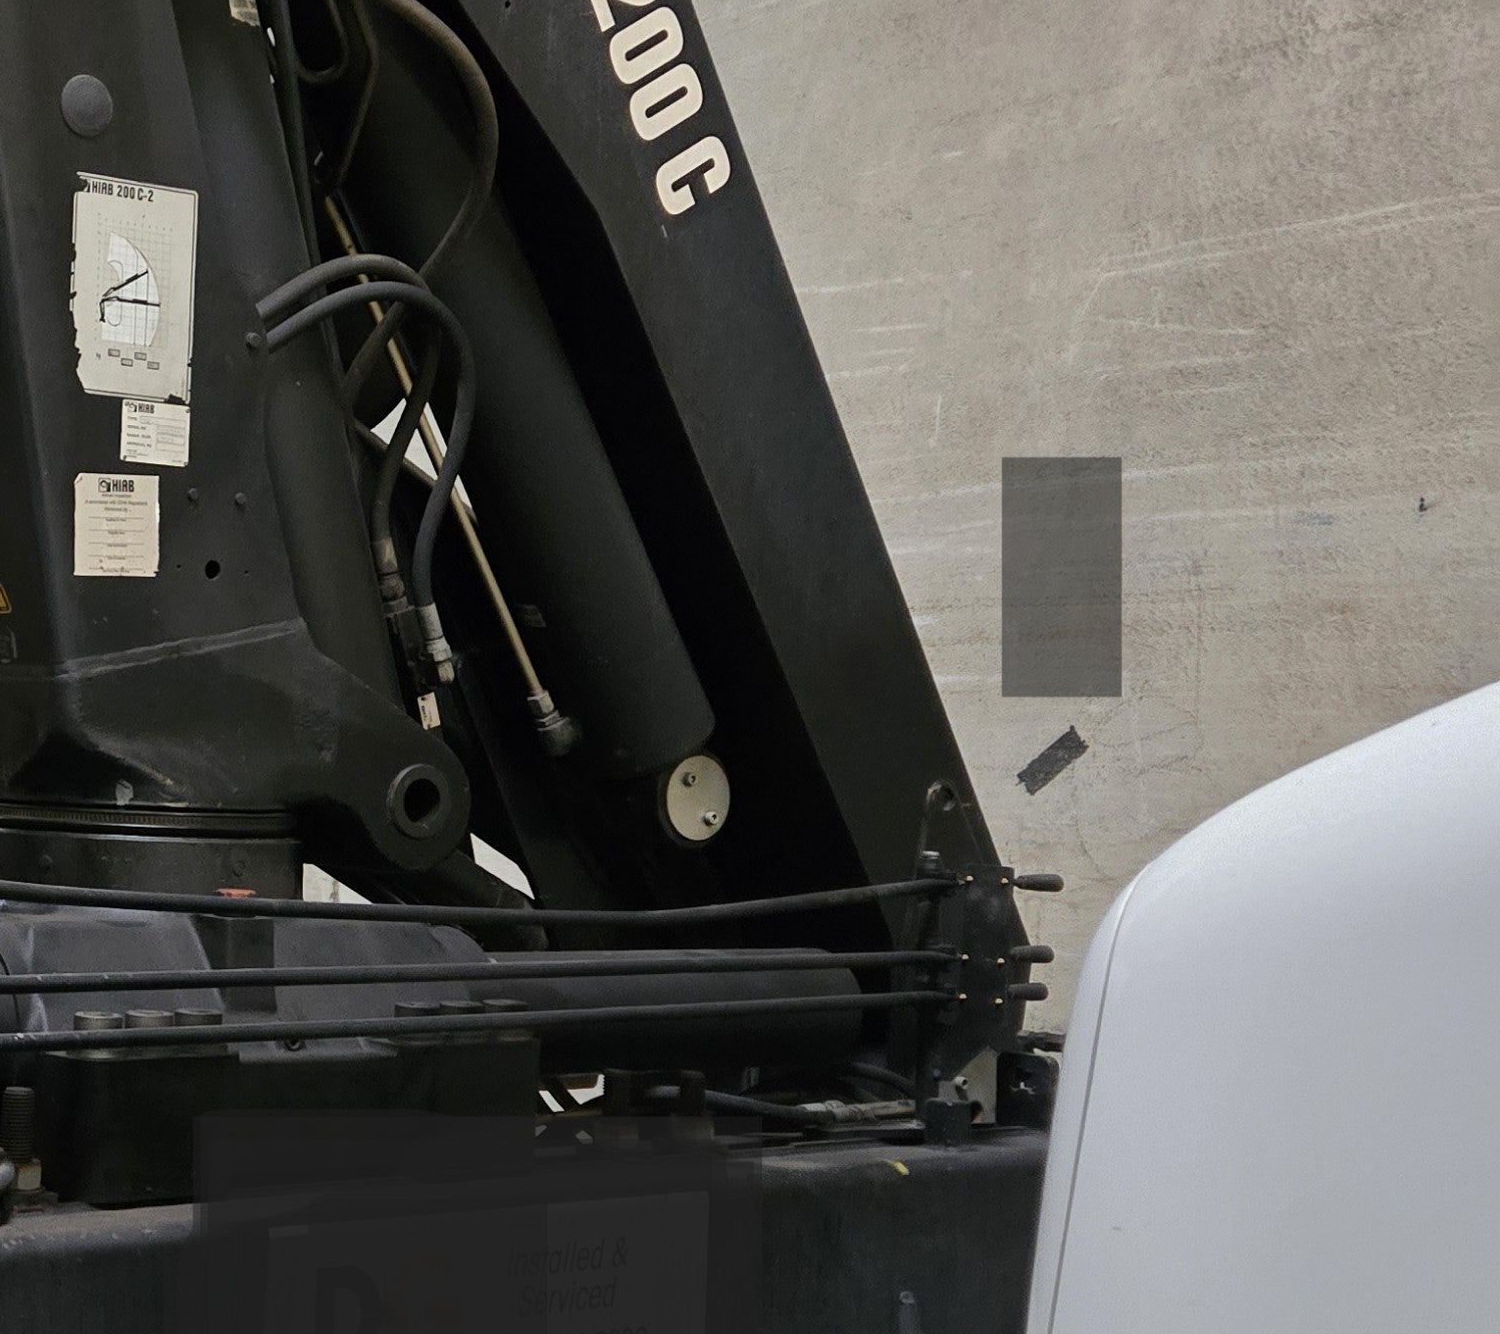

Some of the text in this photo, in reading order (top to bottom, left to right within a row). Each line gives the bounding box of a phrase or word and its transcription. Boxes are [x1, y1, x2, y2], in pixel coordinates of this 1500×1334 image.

[656, 135, 731, 215] C
[92, 181, 154, 202] HIAB 200 C-2
[138, 402, 155, 414] HIAB
[112, 479, 135, 492] HIAB
